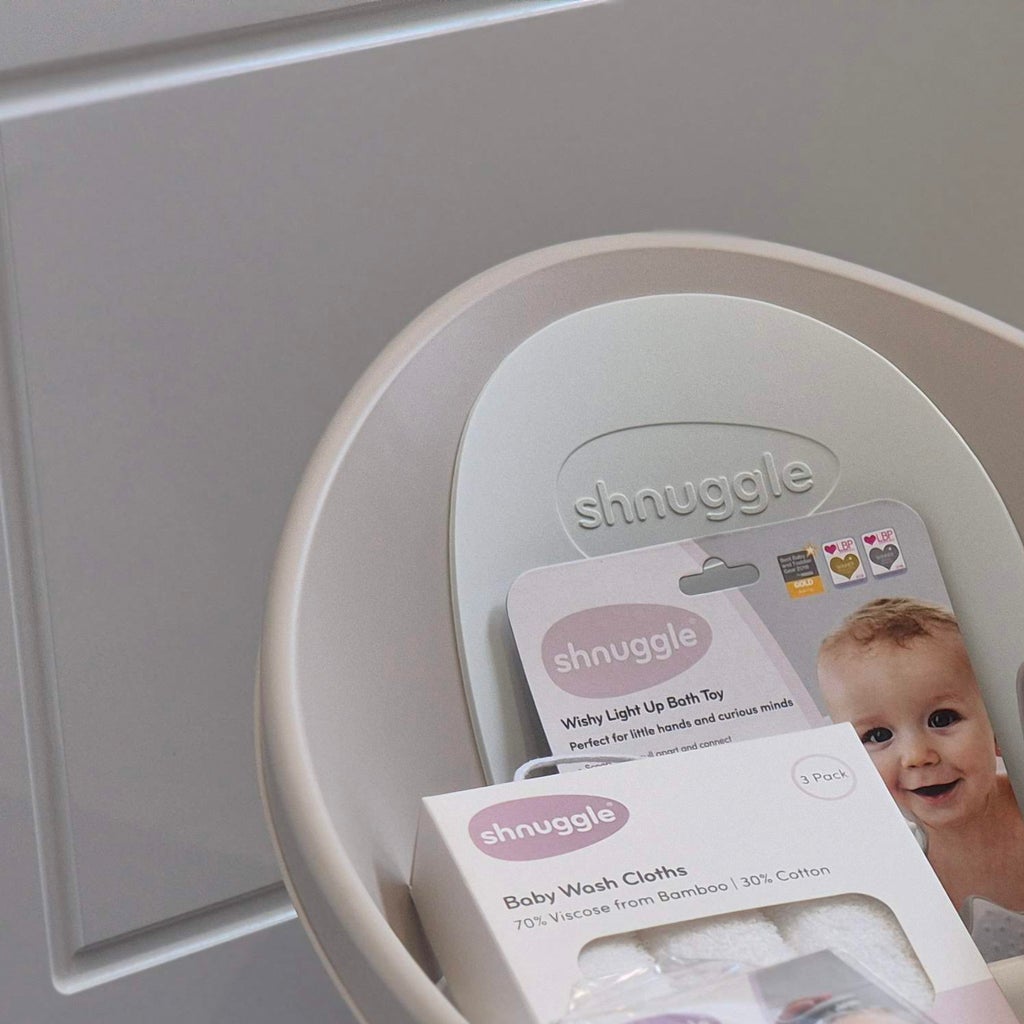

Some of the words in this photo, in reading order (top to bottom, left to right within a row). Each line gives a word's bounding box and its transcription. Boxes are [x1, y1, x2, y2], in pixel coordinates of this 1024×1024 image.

[574, 452, 814, 529] shnuggle
[554, 622, 697, 673] shnuggle
[560, 712, 604, 731] Wishy
[605, 704, 642, 722] Light
[644, 701, 664, 714] Up
[666, 693, 701, 710] Bath
[700, 688, 725, 702] Toy
[569, 735, 610, 752] Perfect
[612, 730, 629, 743] for
[629, 727, 656, 740] little
[656, 719, 692, 734] hands
[694, 712, 716, 727] and
[718, 707, 758, 722] curious
[760, 698, 794, 713] minds
[681, 743, 698, 752] and
[699, 736, 733, 749] connect
[800, 775, 810, 784] 3
[812, 769, 849, 783] Pack
[480, 805, 616, 845] shnuggle
[503, 891, 556, 911] Baby
[557, 877, 619, 898] Wash
[622, 865, 688, 886] Cloths
[513, 915, 548, 931] 70%
[548, 904, 611, 923] Viscose
[614, 896, 654, 911] from
[656, 882, 729, 902] Bamboo
[740, 873, 773, 888] 30%
[775, 866, 831, 882] Cotton
